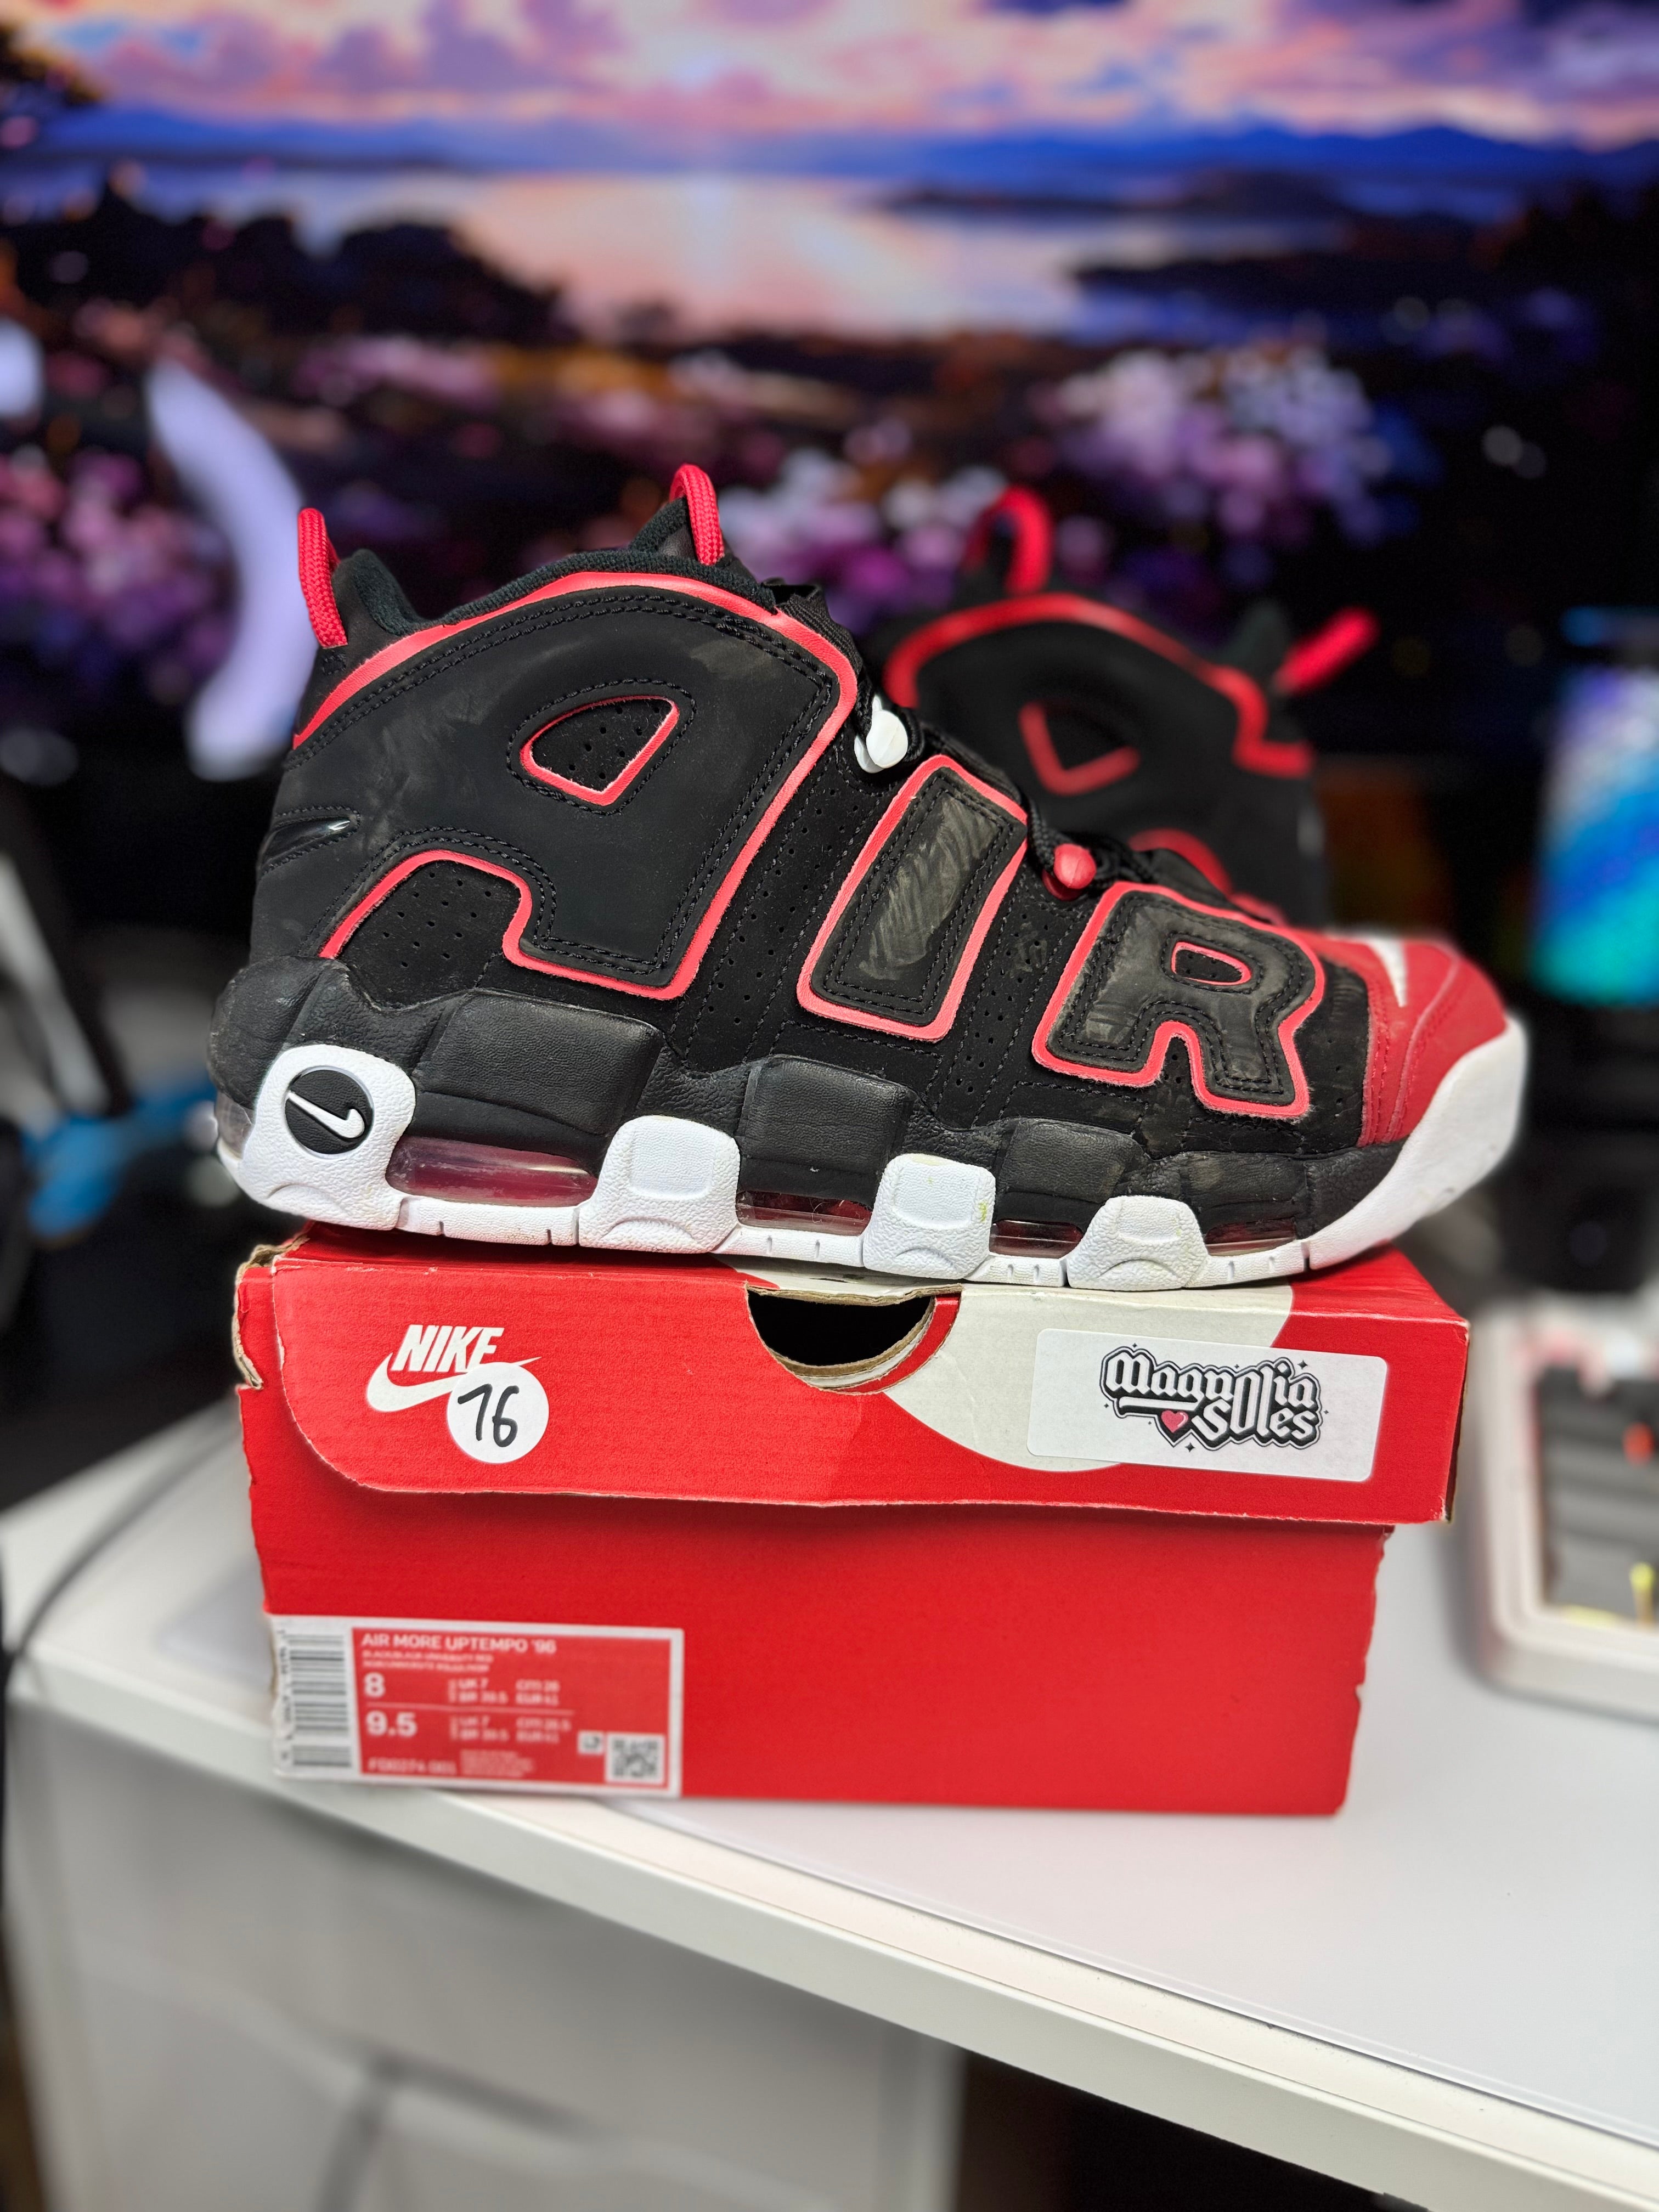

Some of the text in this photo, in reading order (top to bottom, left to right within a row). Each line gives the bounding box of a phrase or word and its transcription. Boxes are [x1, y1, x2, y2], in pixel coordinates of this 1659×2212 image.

[280, 571, 1325, 1119] AIR
[391, 1324, 505, 1373] NIKE
[362, 1634, 390, 1646] AIR
[392, 1634, 442, 1649] MORE
[445, 1637, 528, 1653] UPTEMPO
[364, 1672, 385, 1697] 8
[366, 1711, 417, 1737] 9.5
